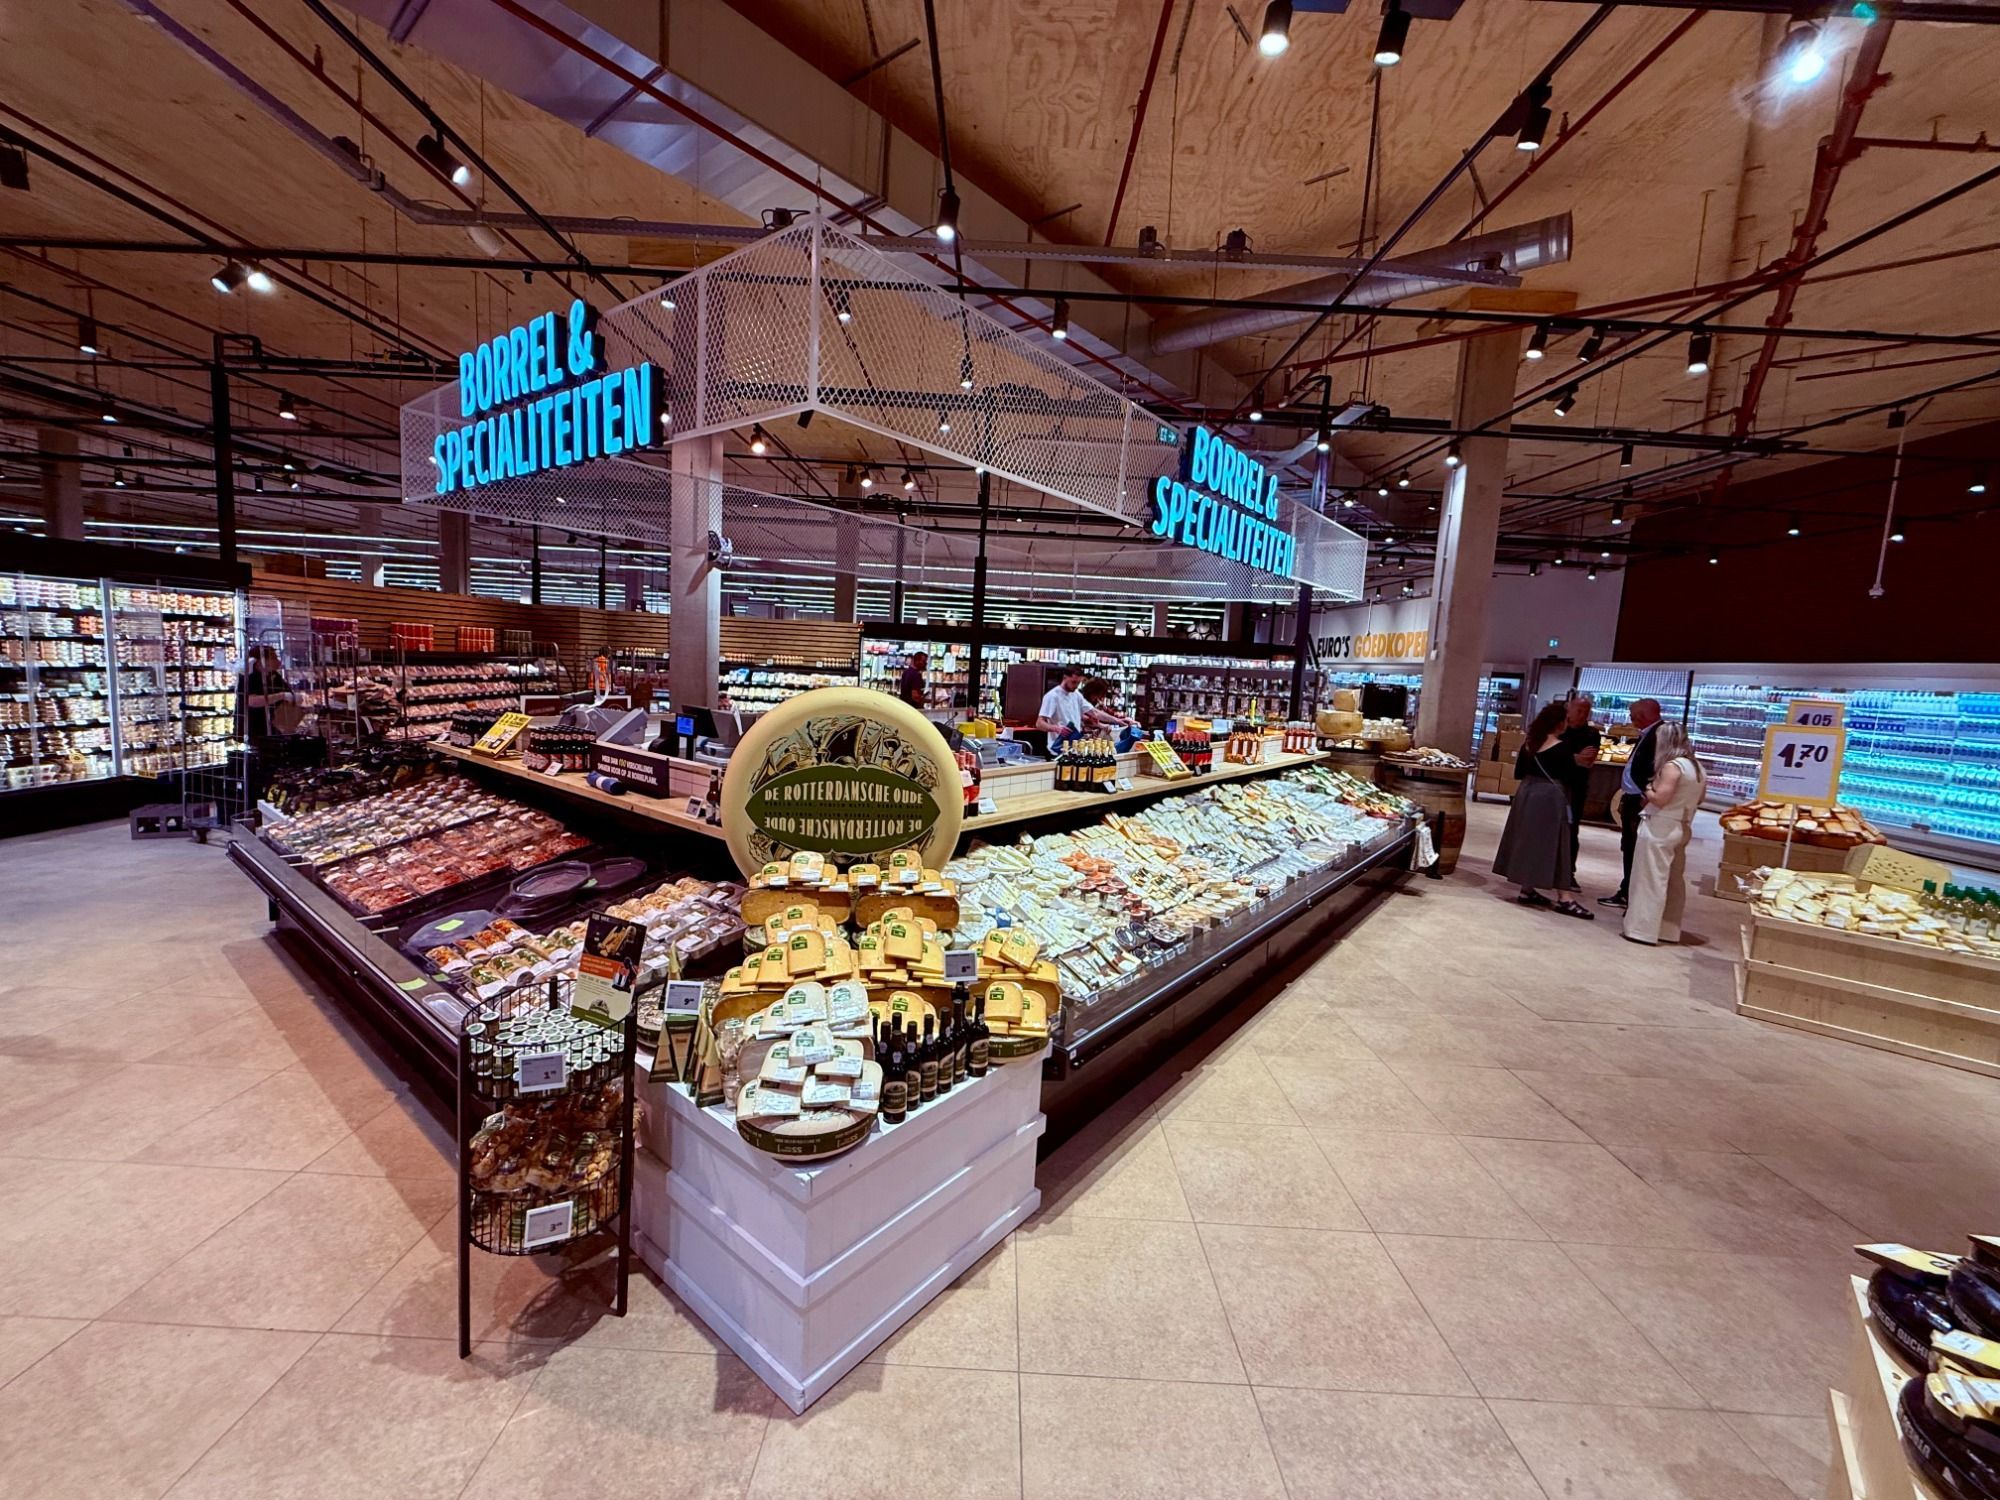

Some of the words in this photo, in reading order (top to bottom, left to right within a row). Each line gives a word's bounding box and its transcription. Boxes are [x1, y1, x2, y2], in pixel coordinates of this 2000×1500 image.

[459, 311, 563, 417] BORREL
[568, 298, 595, 375] &
[434, 361, 651, 495] SPECIALITEITEN
[1191, 425, 1264, 514] BORREL
[1265, 474, 1279, 521] &
[1151, 475, 1296, 579] SPECIALITEITEN
[1777, 743, 1829, 768] 1.70
[764, 787, 779, 801] DE
[784, 780, 890, 802] ROTTERDAMSCHE
[893, 788, 924, 804] OUDE
[764, 816, 796, 833] OUDE
[799, 818, 904, 840] ROTTERDAMSCHE
[908, 819, 923, 832] DE
